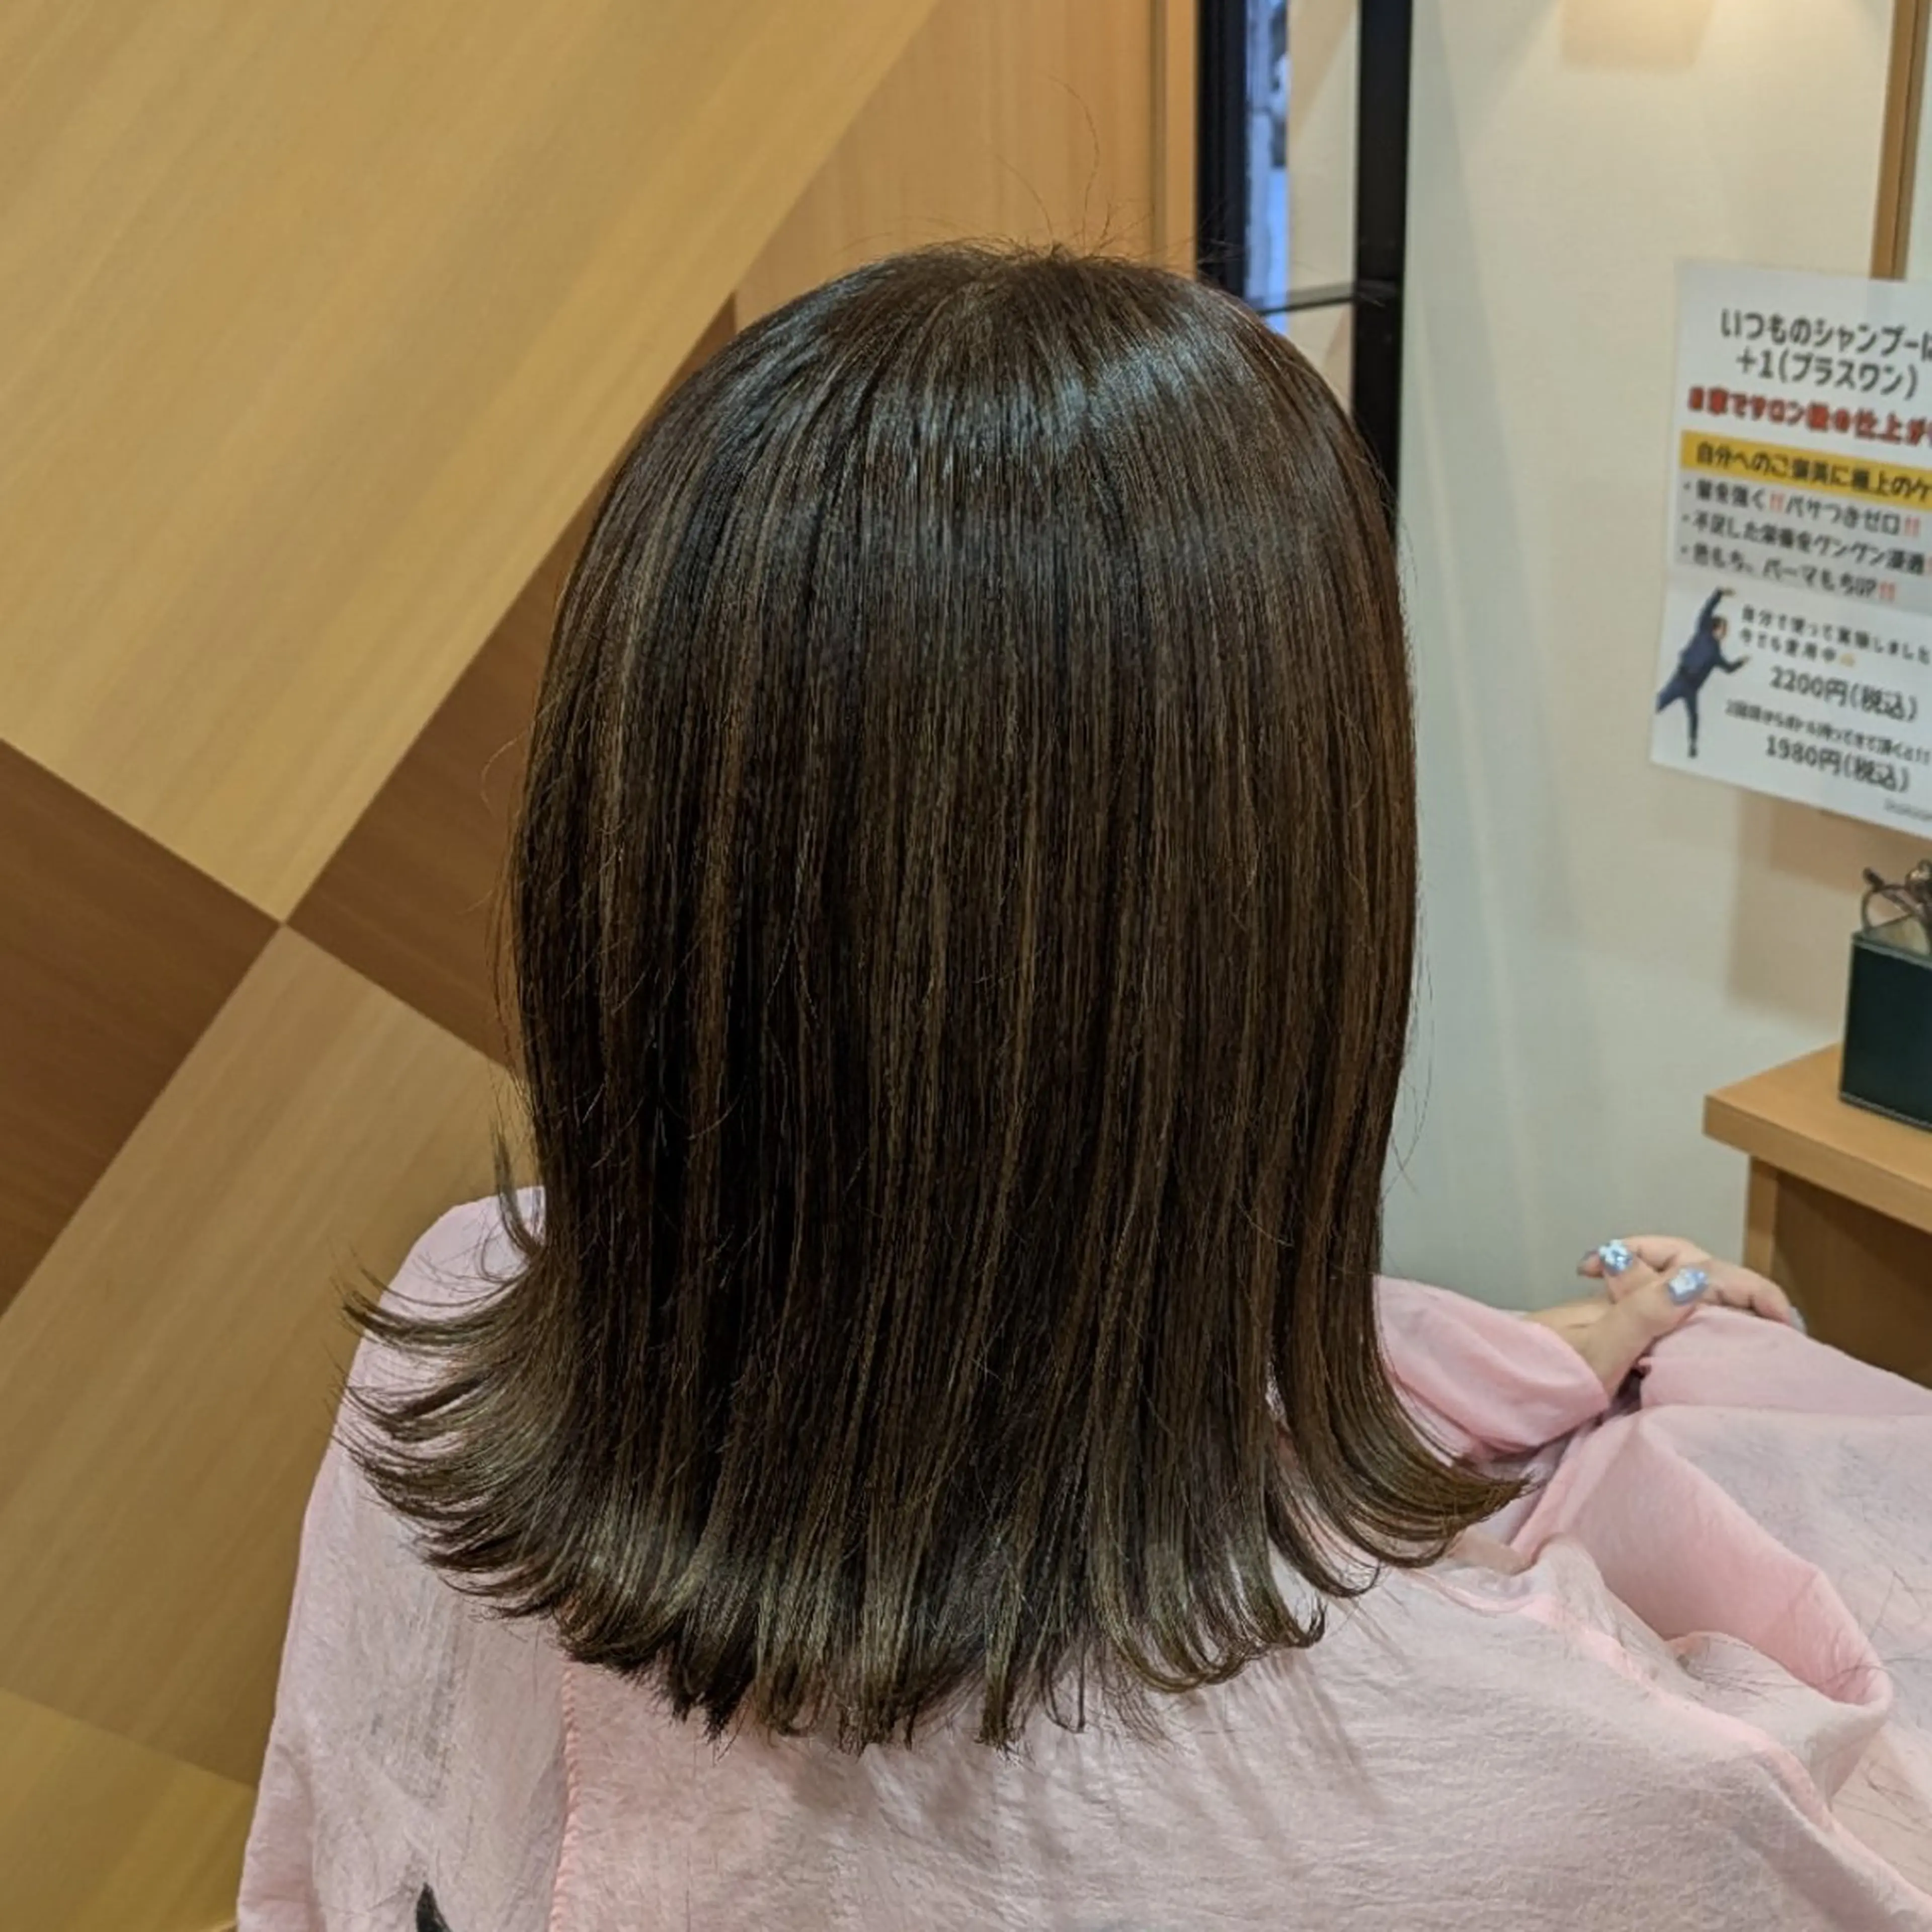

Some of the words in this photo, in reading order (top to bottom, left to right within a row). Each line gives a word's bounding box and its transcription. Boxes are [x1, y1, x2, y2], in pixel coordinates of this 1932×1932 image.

[1769, 666, 1918, 722] 2200円(税込)
[1766, 735, 1910, 793] 1980円(税込)
